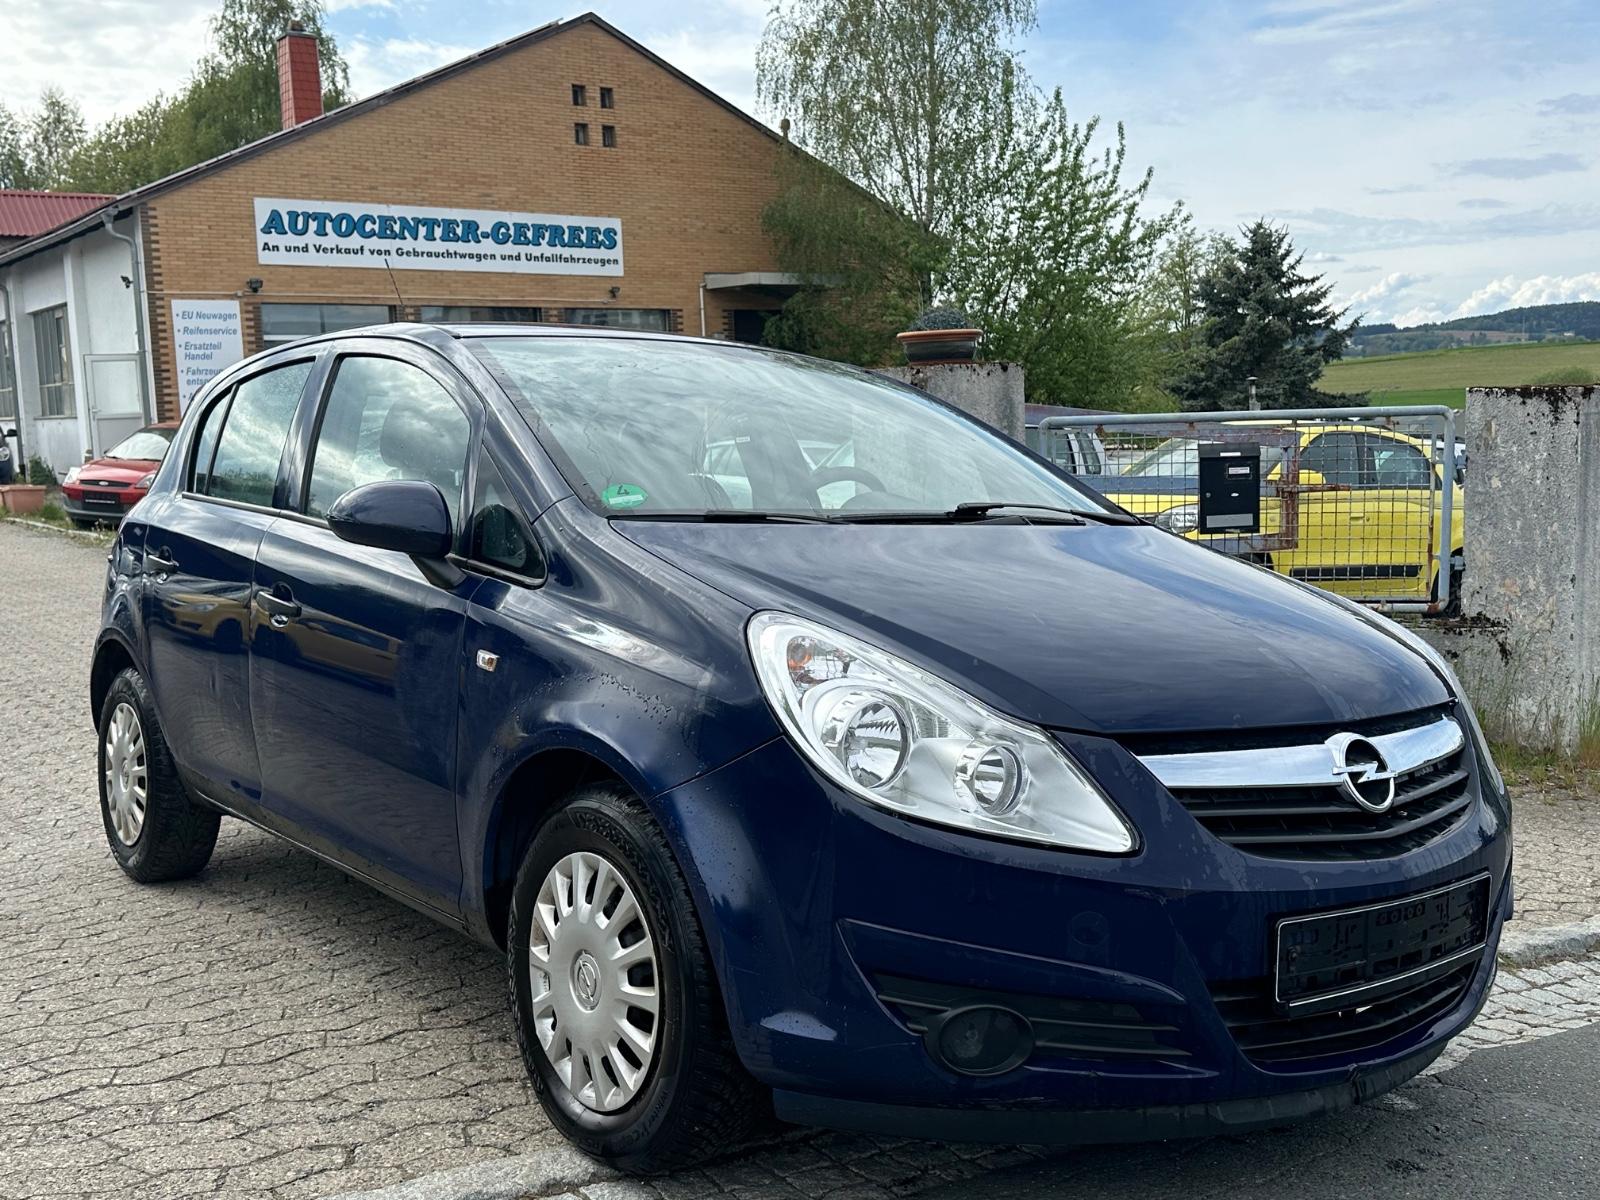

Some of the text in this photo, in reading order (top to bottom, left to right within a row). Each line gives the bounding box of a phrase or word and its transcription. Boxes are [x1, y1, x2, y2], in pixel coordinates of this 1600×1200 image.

[260, 209, 618, 250] AUTOCENTER-GEFREES
[262, 242, 619, 267] An und Verkauf von Gebrauchtwagen und Unfallfahrzeugen
[182, 311, 237, 322] EU Neuwagen
[183, 327, 237, 335] Reifenservice
[184, 342, 222, 351] Ersatzteil
[184, 352, 213, 361] Handel
